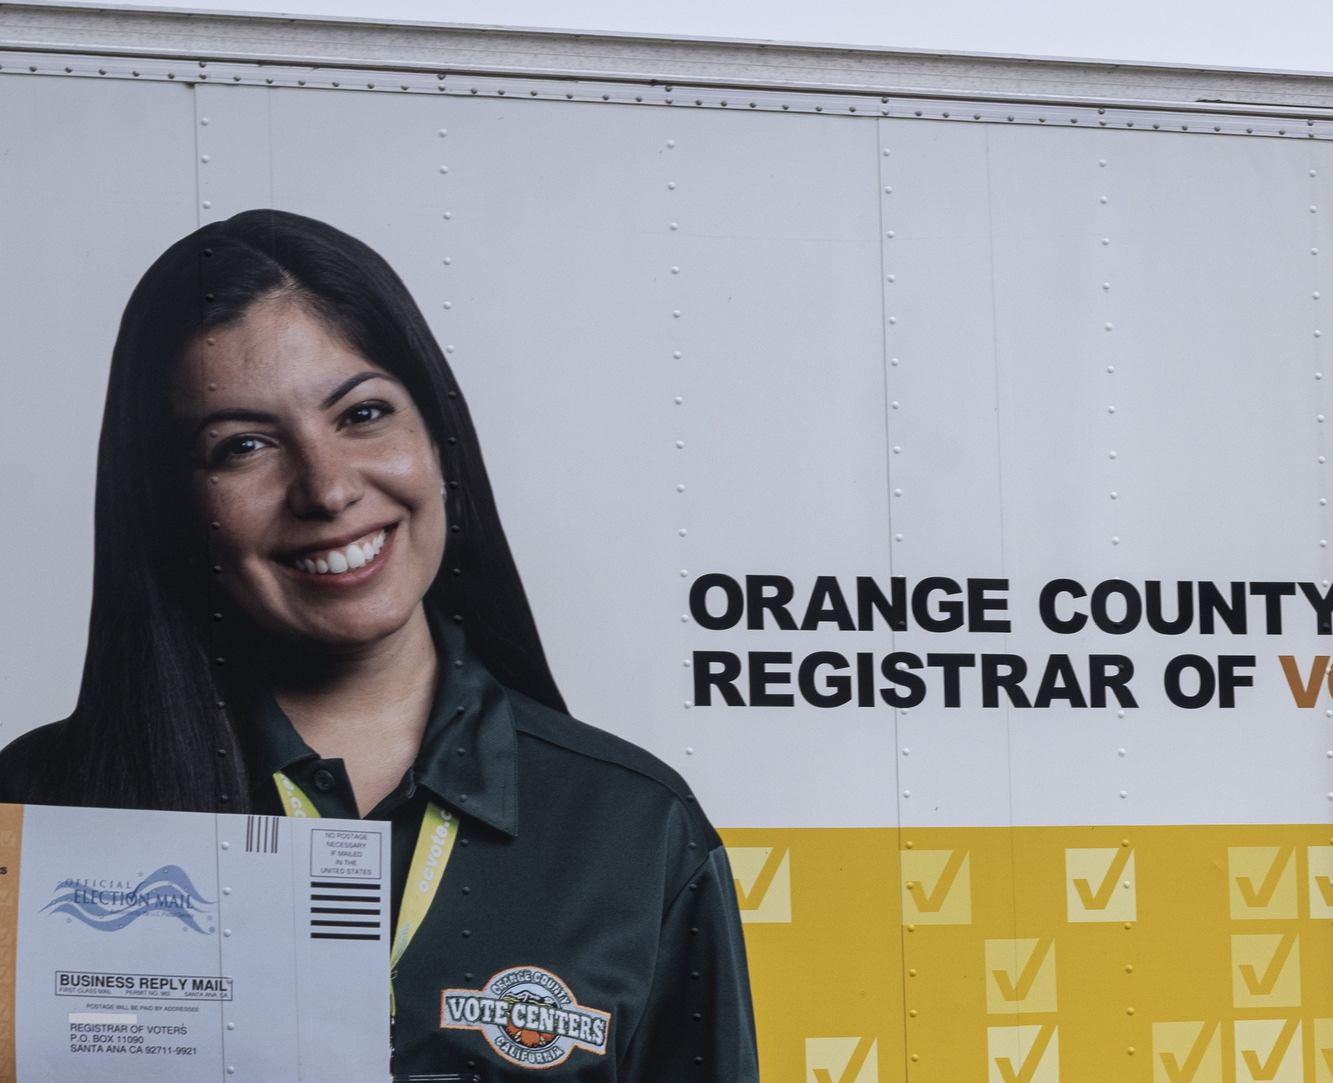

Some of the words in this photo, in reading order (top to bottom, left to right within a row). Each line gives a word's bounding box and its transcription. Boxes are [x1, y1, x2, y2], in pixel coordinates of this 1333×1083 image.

[689, 573, 1012, 633] ORANGE
[692, 650, 1140, 709] REGISTRAR
[1163, 653, 1256, 709] OF
[65, 878, 132, 890] OFFICIAL
[73, 888, 151, 907] ELECTION
[154, 894, 194, 909] MAIL
[60, 974, 135, 989] BUSINESS
[139, 977, 187, 991] REPLY
[192, 979, 228, 992] MAIL
[491, 970, 531, 995] ORANGE
[533, 971, 571, 1005] COUNTY
[70, 1023, 128, 1033] REGISTRAR
[130, 1025, 144, 1034] OF
[146, 1025, 187, 1035] VOTERS
[447, 996, 510, 1026] VOTE
[511, 1002, 606, 1046] CENTERS
[70, 1034, 90, 1043] P.O.
[93, 1034, 114, 1043] BOX
[117, 1035, 144, 1044] 11090
[70, 1044, 104, 1053] SANTA
[106, 1045, 127, 1054] ANA
[128, 1045, 142, 1054] CA
[145, 1046, 197, 1055] 92711-9921
[494, 1035, 565, 1064] CALIFORNIA
